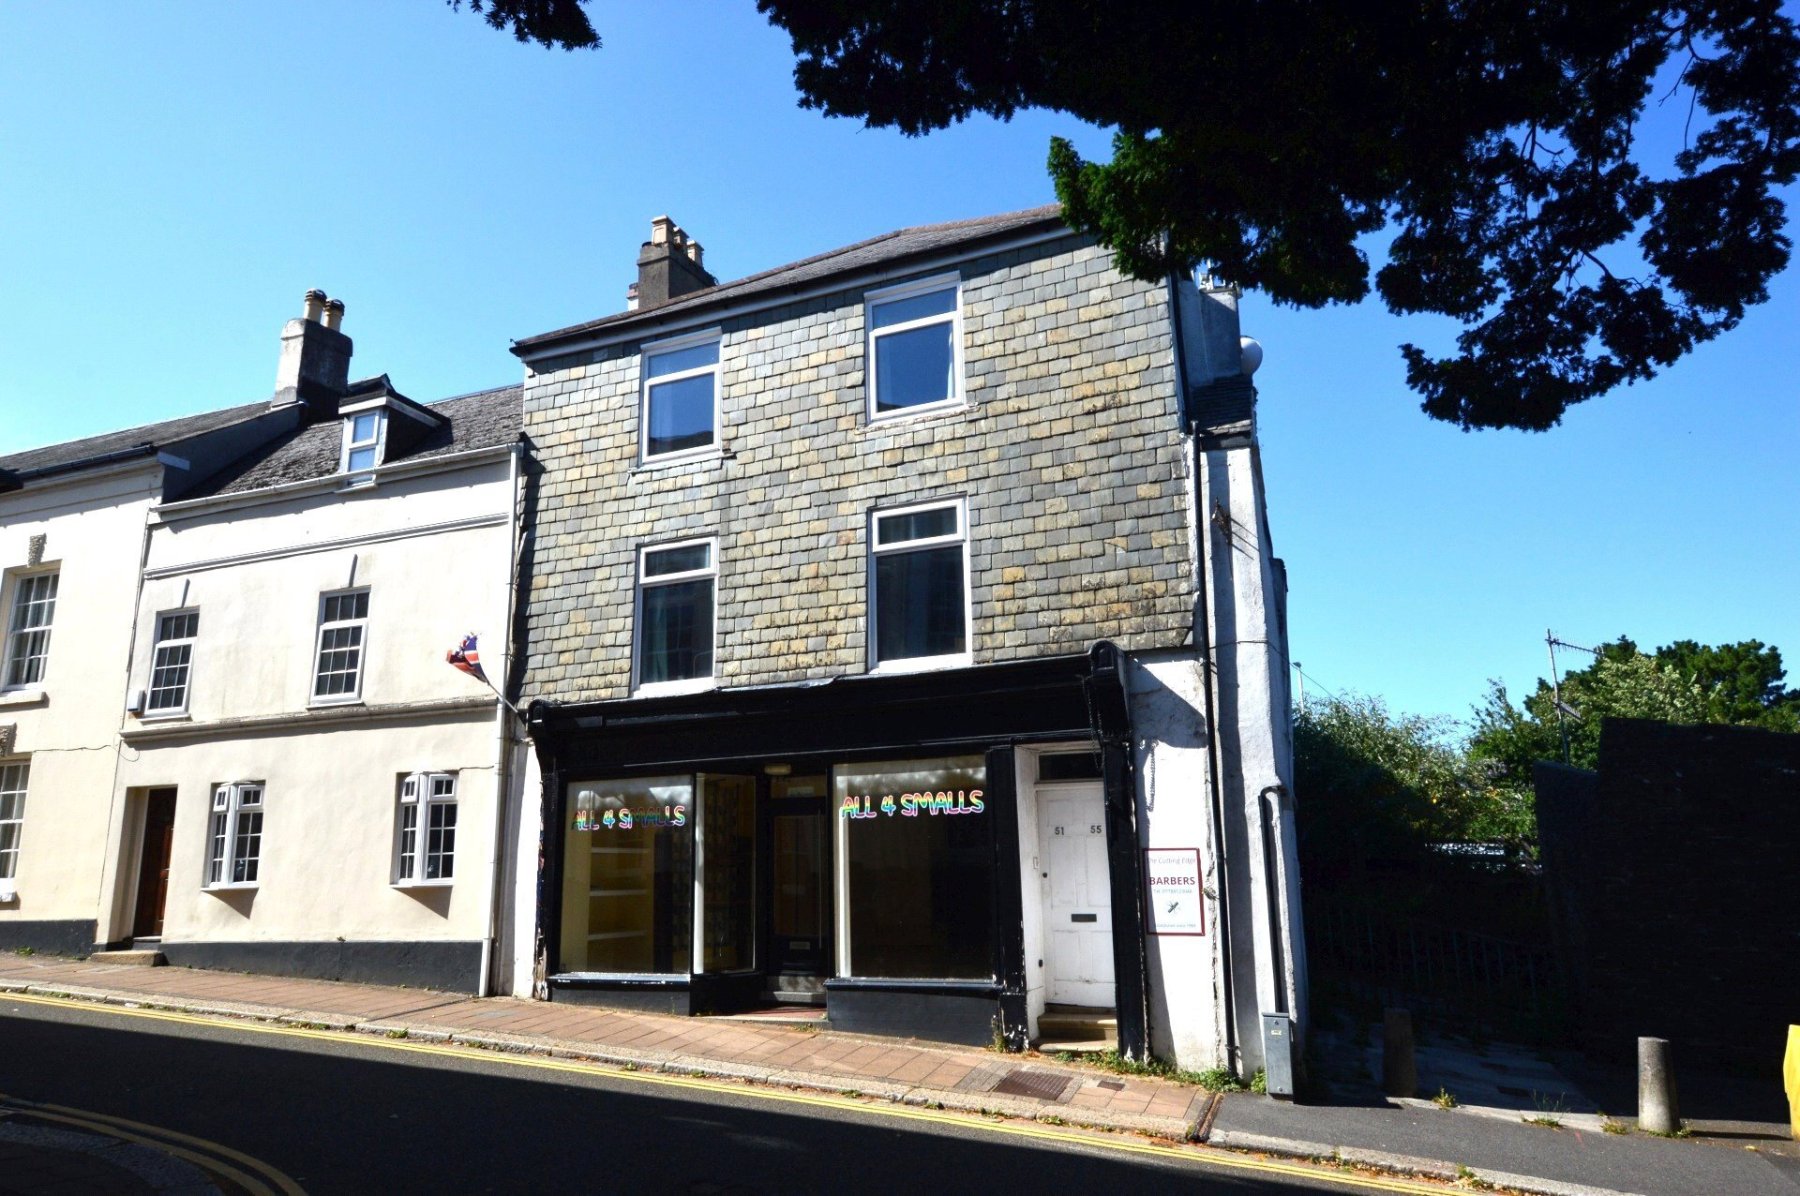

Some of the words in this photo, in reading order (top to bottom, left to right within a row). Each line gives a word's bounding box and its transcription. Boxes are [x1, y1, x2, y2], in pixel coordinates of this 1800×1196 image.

[841, 795, 877, 819] ALL
[880, 794, 897, 817] 4
[900, 789, 985, 817] SMALLS
[572, 810, 600, 831] ALL
[602, 809, 616, 829] 4
[618, 805, 686, 829] SMALLS
[1054, 826, 1065, 836] 51
[1090, 824, 1102, 834] 55
[1149, 876, 1196, 886] BARBERS
